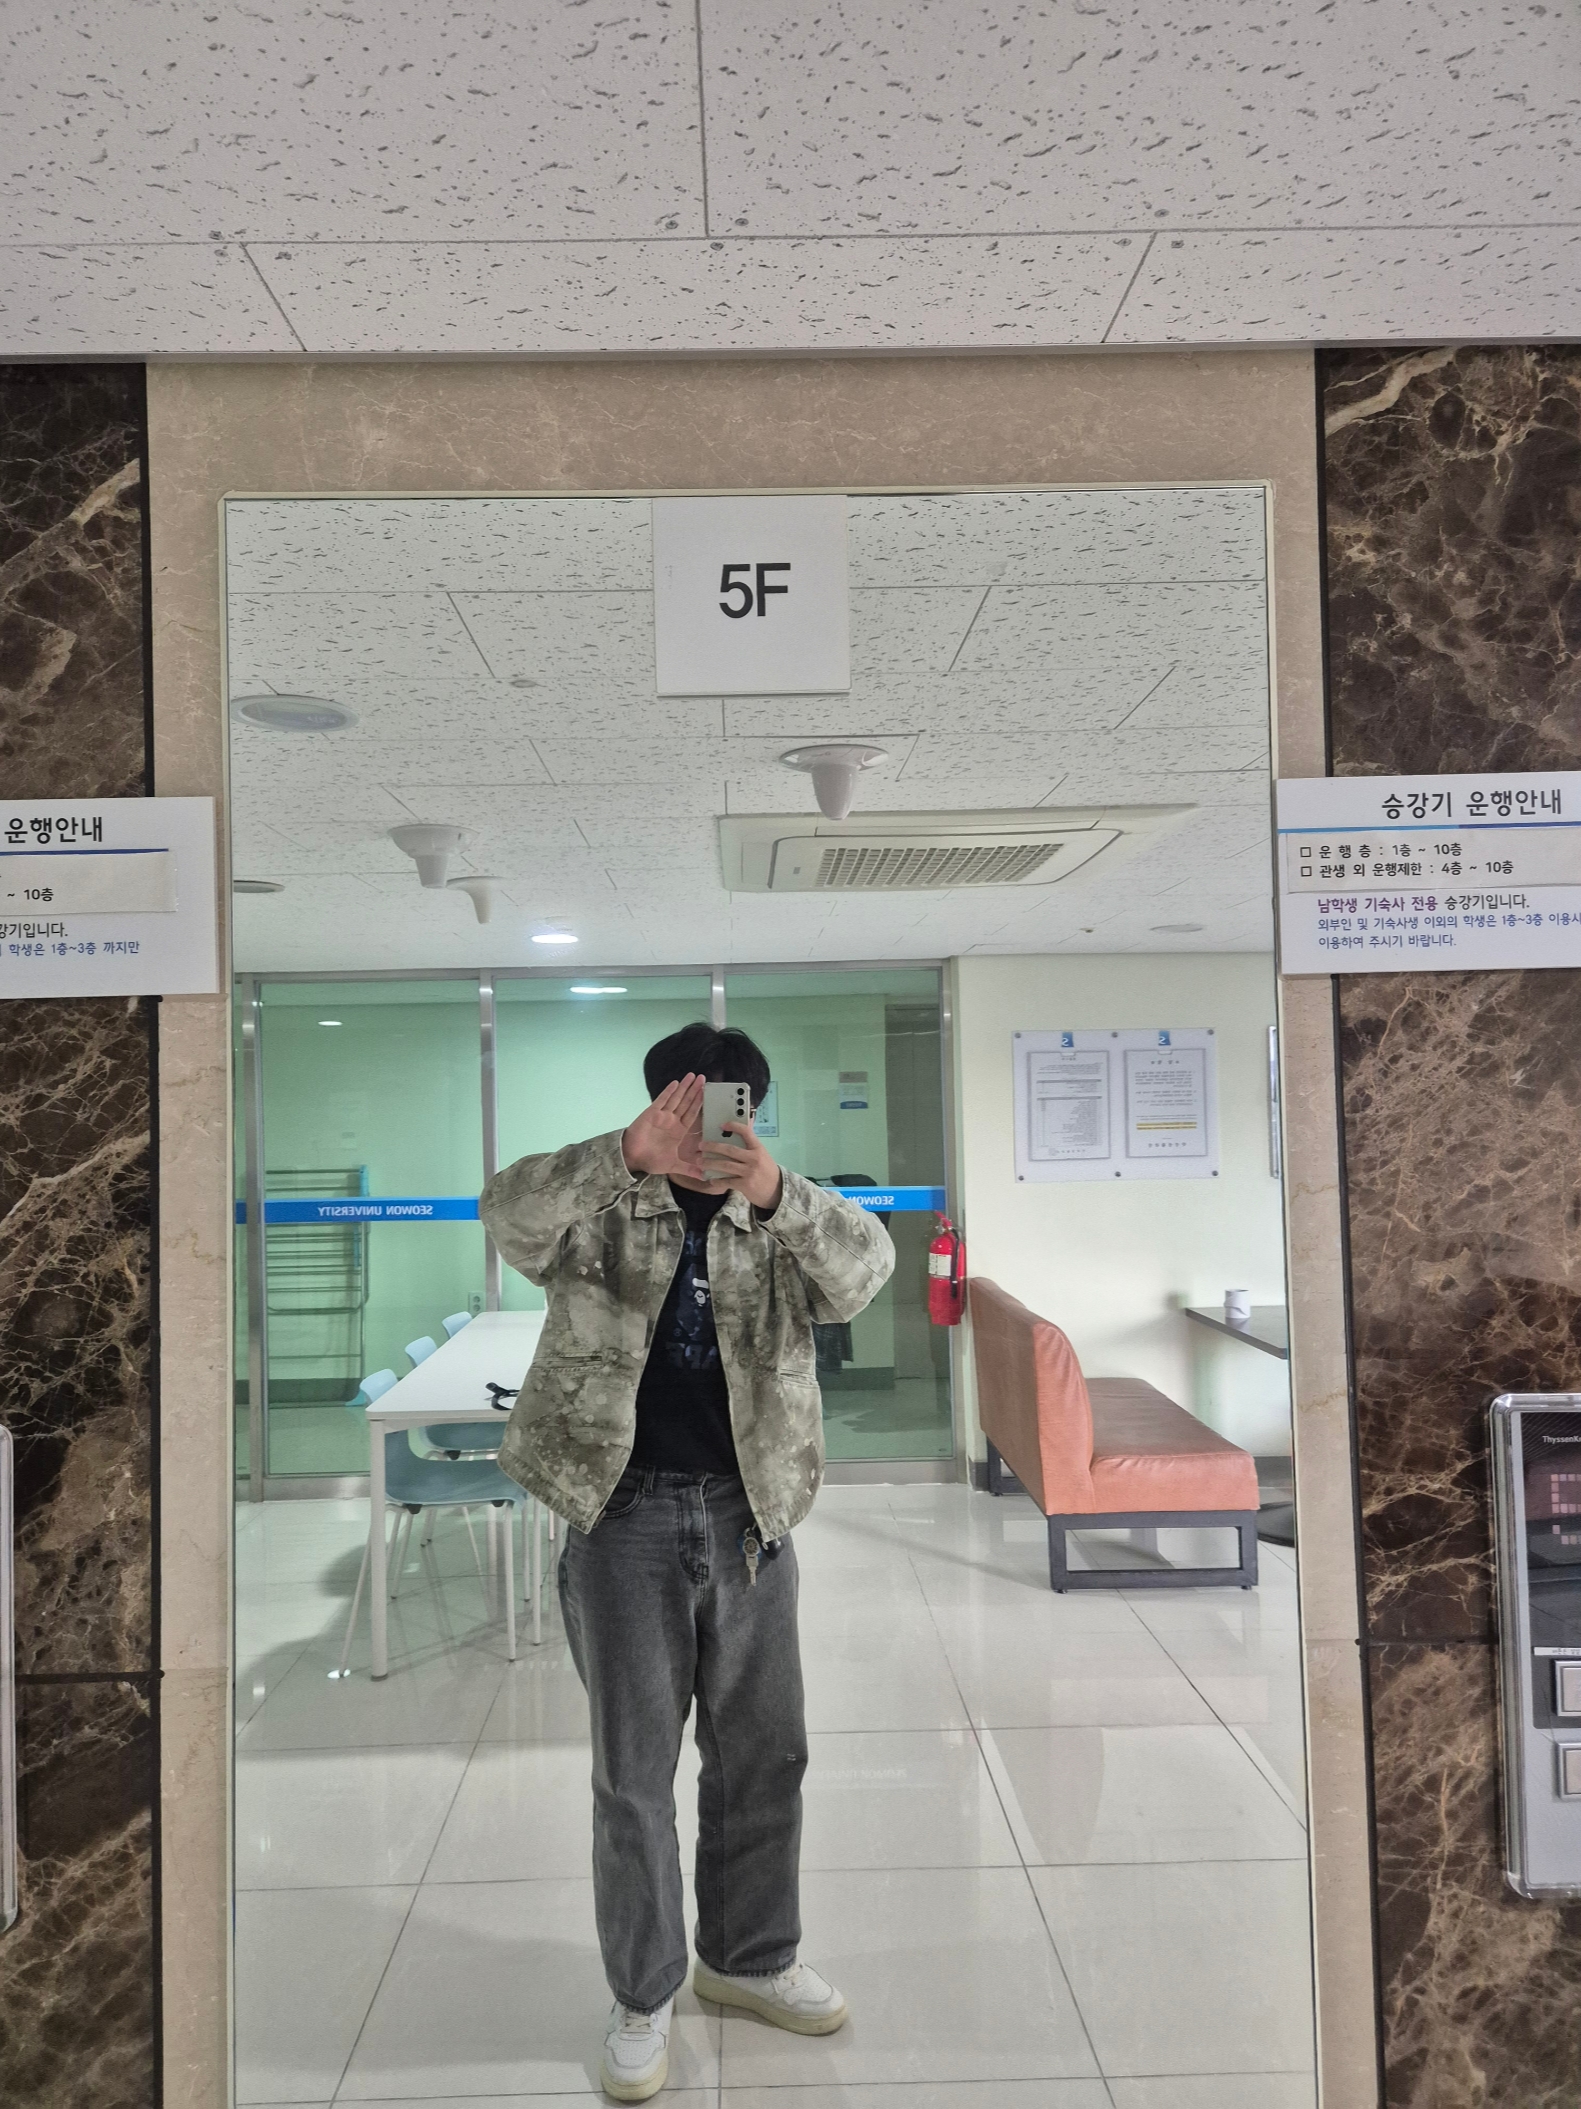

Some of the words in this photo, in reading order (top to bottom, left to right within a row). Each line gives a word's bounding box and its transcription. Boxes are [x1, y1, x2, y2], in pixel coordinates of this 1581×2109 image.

[718, 562, 791, 619] 5F
[1381, 791, 1452, 819] 승강기
[1465, 788, 1562, 817] 운행안내
[4, 816, 103, 844] 운행안내
[1318, 845, 1332, 859] 운
[1338, 844, 1352, 859] 행
[1358, 844, 1371, 858] 층
[1392, 843, 1411, 857] 1층
[1433, 842, 1463, 857] 10층
[1319, 864, 1346, 878] 관생
[1353, 863, 1366, 877] 외
[1372, 862, 1422, 877] 운행제한
[1441, 861, 1463, 876] 4층
[1485, 860, 1514, 874] 10층
[23, 887, 54, 902] 10층
[1317, 898, 1358, 914] 남학생
[1364, 896, 1405, 913] 기숙사
[1411, 895, 1438, 912] 전용
[1444, 893, 1530, 911] 승강기입니다.
[1317, 918, 1352, 932] 외부인
[1357, 918, 1368, 931] 및
[1373, 916, 1419, 931] 기숙사생
[1423, 915, 1458, 928] 이외의
[1463, 913, 1497, 928] 학생은
[1502, 912, 1543, 927] 1층~3층
[9, 942, 45, 957] 학생은
[51, 942, 97, 956] 1층~3층
[103, 940, 140, 955] 까지만
[1318, 936, 1364, 950] 이용하여
[1368, 935, 1403, 949] 주시기
[1408, 933, 1457, 948] 바랍니다.
